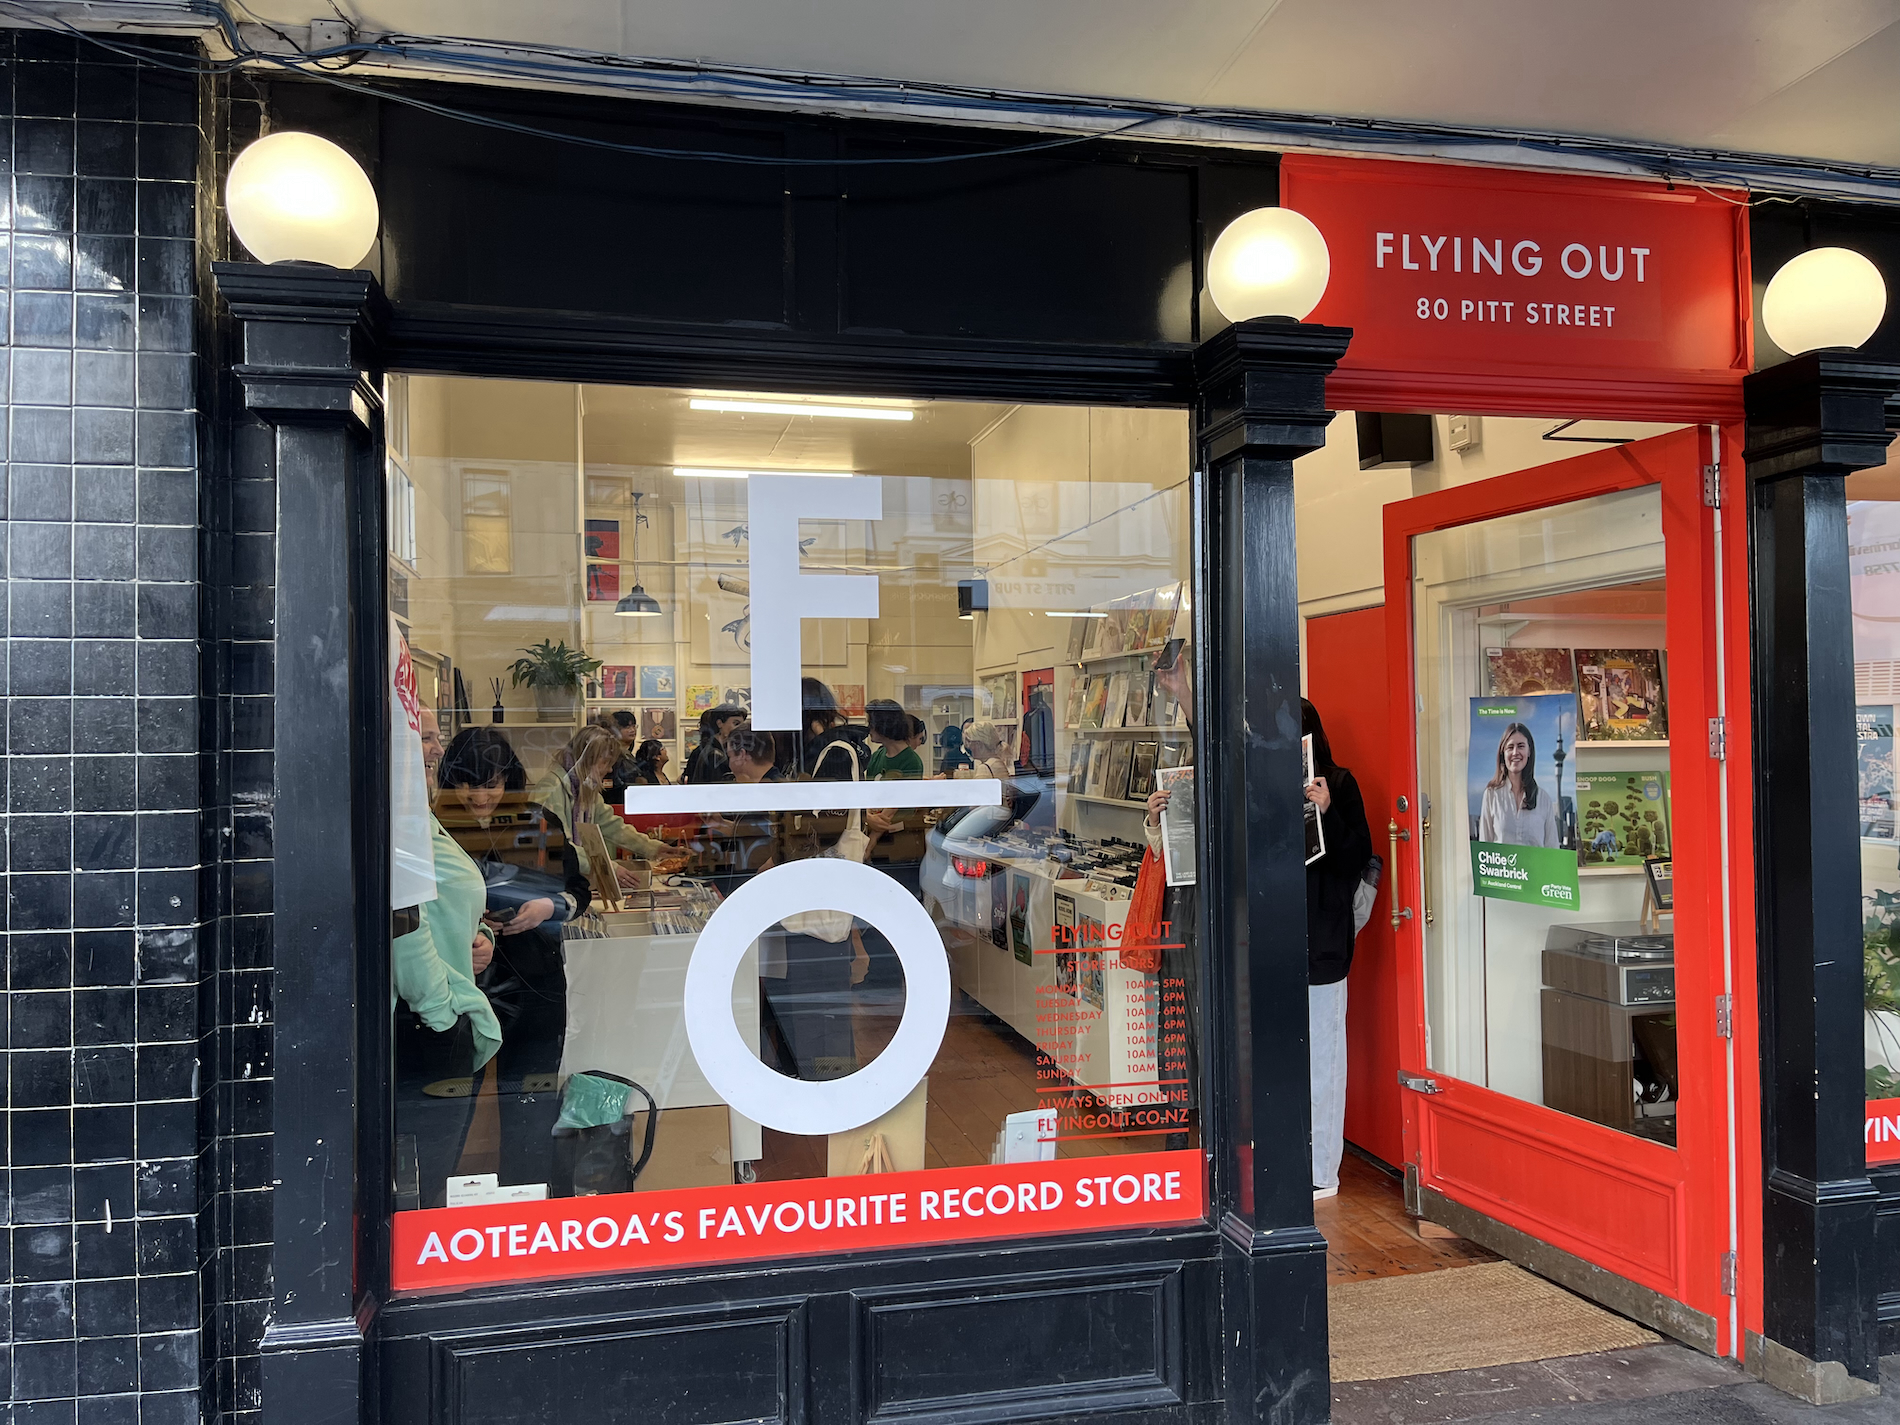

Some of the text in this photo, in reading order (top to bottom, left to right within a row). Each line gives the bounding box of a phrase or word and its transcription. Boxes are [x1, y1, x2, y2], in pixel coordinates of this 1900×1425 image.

[1376, 231, 1651, 283] FLYING OUT
[1416, 297, 1616, 328] 80 PITT STREET
[748, 474, 883, 732] F
[1478, 851, 1507, 866] Chlöe
[1479, 863, 1528, 881] Swarbrick
[1541, 884, 1572, 900] Green
[1051, 923, 1123, 943] FLYING
[1130, 921, 1172, 940] OUT
[1067, 957, 1155, 972] STORE HOURS
[1035, 983, 1085, 994] MONDAY
[1125, 980, 1154, 990] 10AM
[1163, 978, 1185, 988] 5PM
[685, 858, 951, 1135] O
[1036, 998, 1082, 1009] TUESDAY
[1125, 994, 1154, 1003] 10AM
[1163, 992, 1186, 1002] 6PM
[1036, 1011, 1103, 1023] WEDNESDAY
[1126, 1008, 1154, 1017] 10AM
[1163, 1006, 1186, 1015] 6PM
[1036, 1025, 1091, 1037] THURSDAY
[1126, 1021, 1155, 1031] 10AM
[1163, 1020, 1186, 1030] 6PM
[1036, 1041, 1074, 1052] FRIDAY
[1126, 1036, 1155, 1045] 10AM
[1164, 1034, 1186, 1043] 6PM
[1036, 1053, 1091, 1066] SATURDAY
[1127, 1050, 1156, 1059] 10AM
[1164, 1048, 1186, 1058] 6PM
[1036, 1068, 1082, 1080] SUNDAY
[1127, 1063, 1156, 1073] 10AM
[1164, 1062, 1187, 1072] 5PM
[1038, 1089, 1189, 1110] ALWAYS OPEN ONLINE
[1038, 1109, 1189, 1132] FLYINGOUT.CO.NZ
[416, 1171, 1181, 1266] AOTEAROA'S FAVOURITE RECORD STORE
